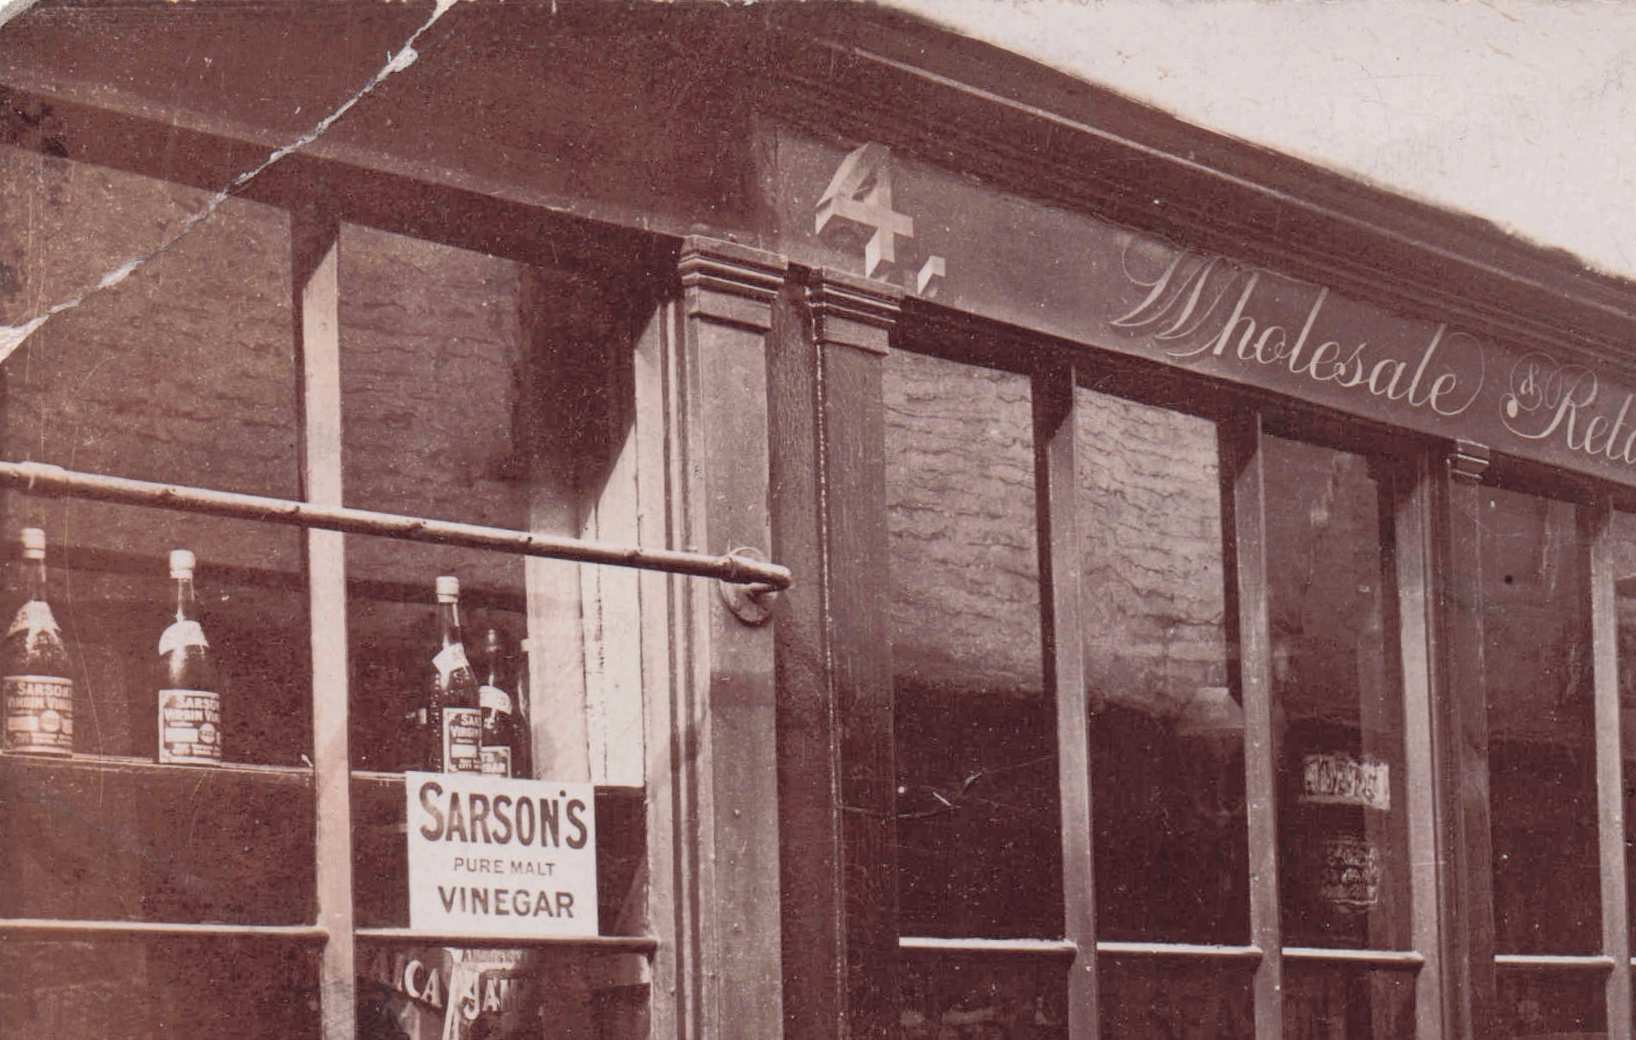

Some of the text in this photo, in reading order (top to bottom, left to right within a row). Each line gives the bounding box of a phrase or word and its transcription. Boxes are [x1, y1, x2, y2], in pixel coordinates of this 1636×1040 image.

[1109, 242, 1485, 416] Wholesale
[419, 781, 588, 850] SARSON'S
[454, 857, 555, 877] PURE MALT
[438, 885, 574, 919] VINEGAR
